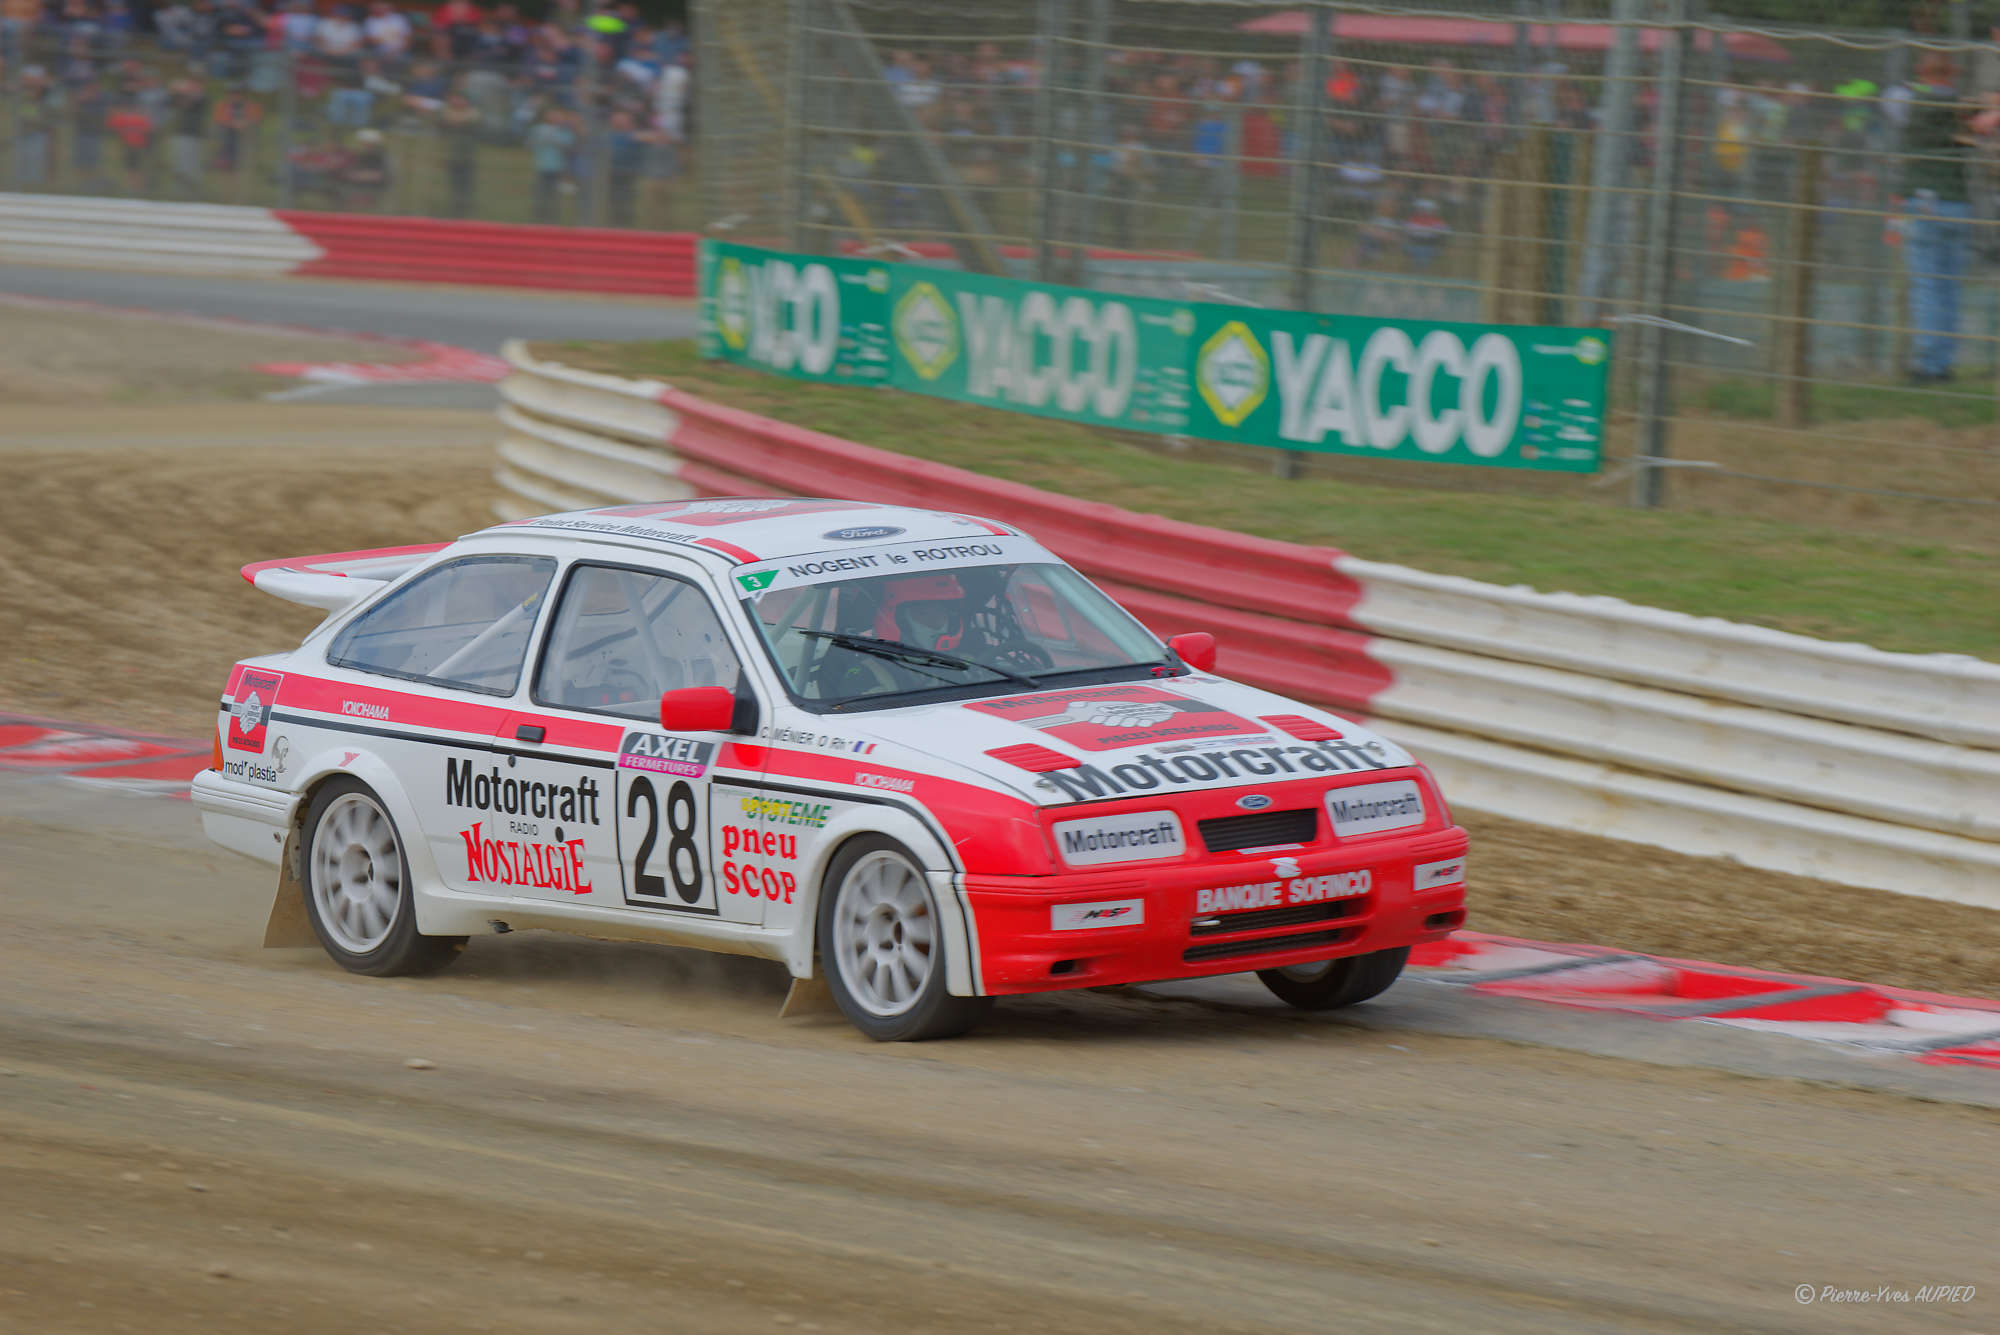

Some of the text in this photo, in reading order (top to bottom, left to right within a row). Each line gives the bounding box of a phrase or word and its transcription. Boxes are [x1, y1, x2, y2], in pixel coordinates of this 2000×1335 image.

[956, 291, 1137, 418] YACCO
[1270, 327, 1522, 457] YACCO
[617, 525, 698, 542] Motorcraft
[840, 527, 889, 539] Ford
[787, 555, 883, 577] NOGENT
[889, 552, 908, 565] le
[913, 543, 1004, 564] ROTROU
[747, 576, 763, 588] 3
[341, 700, 389, 720] YOKOHAMA
[983, 687, 1148, 710] Motorcraft
[630, 734, 700, 763] AXEL
[248, 765, 277, 783] plastia
[625, 756, 698, 777] FERMETURES
[1041, 740, 1388, 801] Motorcraft
[446, 757, 600, 826] Motorcraft
[853, 772, 915, 793] YOKOHAMA
[1333, 793, 1421, 823] Motorcraft
[510, 821, 538, 836] RADIO
[627, 775, 703, 904] 28
[722, 825, 797, 860] pneu
[1064, 821, 1177, 854] Motorcraft
[459, 822, 592, 895] NOSTALGIE
[723, 861, 796, 904] SCOP
[1196, 869, 1372, 914] BANQUE SOFINCO
